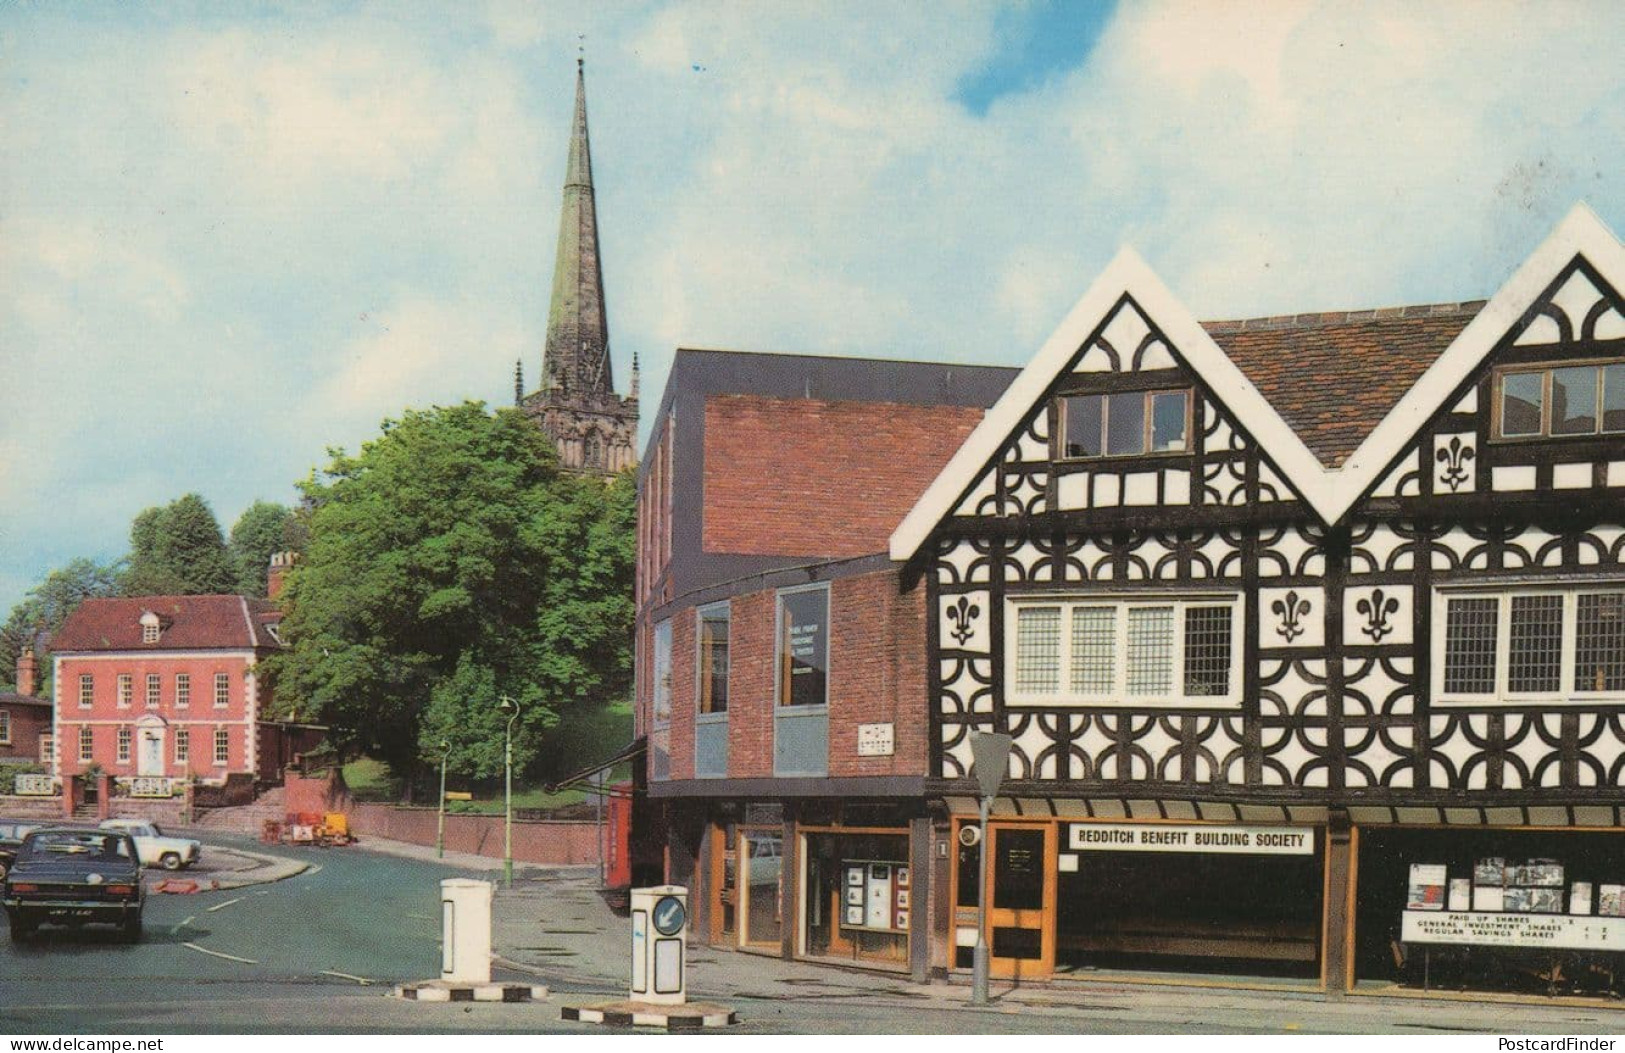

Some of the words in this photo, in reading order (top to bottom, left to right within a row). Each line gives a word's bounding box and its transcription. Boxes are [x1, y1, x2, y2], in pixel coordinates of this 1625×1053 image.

[1079, 830, 1134, 843] REDDITCH
[1141, 831, 1188, 845] BENEFIT
[1195, 832, 1249, 846] BUILDING
[1256, 833, 1305, 847] SOCIETY
[1417, 920, 1458, 928] GENERAL
[1464, 922, 1520, 930] INVESTMENT
